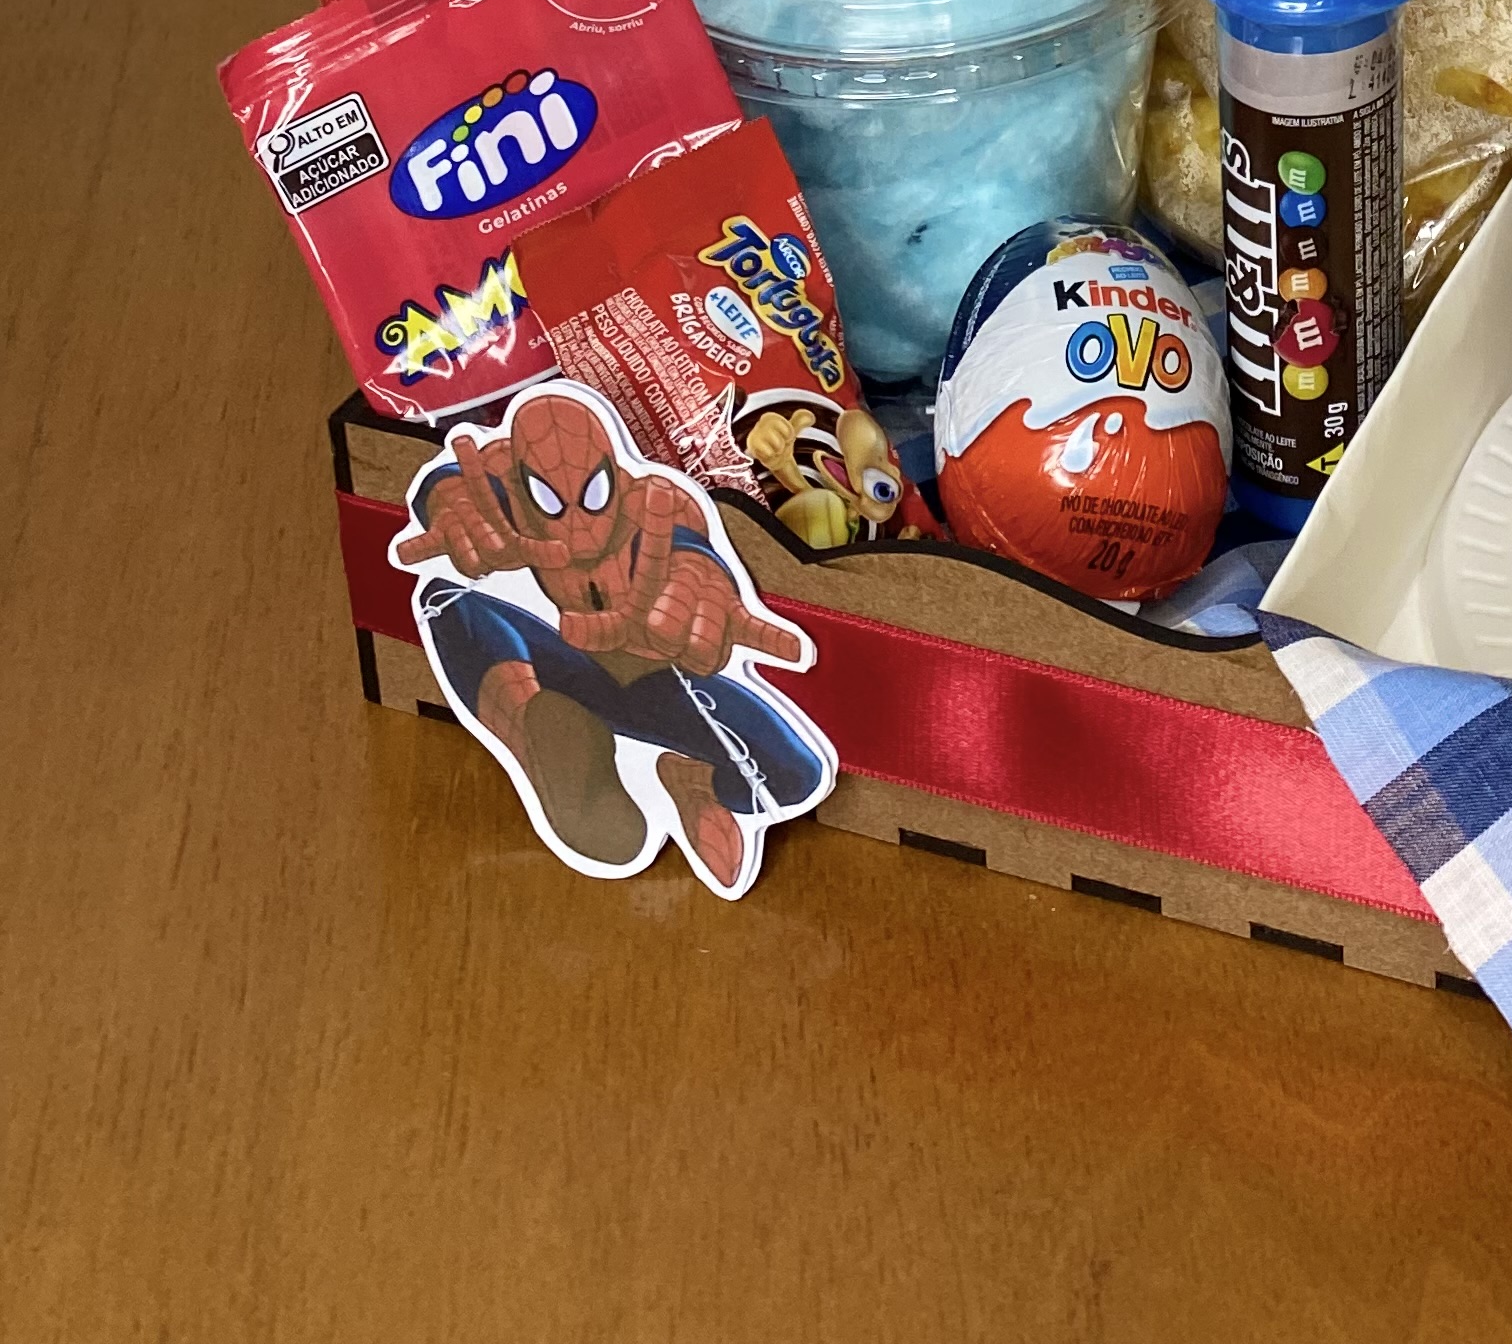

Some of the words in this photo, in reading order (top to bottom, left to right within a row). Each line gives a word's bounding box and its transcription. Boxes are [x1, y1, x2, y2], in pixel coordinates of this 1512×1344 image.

[569, 18, 606, 36] Abriu,
[608, 17, 644, 35] sorriu
[296, 118, 334, 149] ALTO
[334, 109, 360, 137] EM
[1272, 116, 1299, 127] IMAGEM
[1301, 114, 1345, 128] ILUSTRATIVA
[406, 71, 579, 213] Fini
[290, 152, 381, 206] ADICIONADO
[299, 143, 361, 184] AÇÚCAR
[1289, 168, 1306, 189] m
[478, 182, 568, 235] Gelatinas
[1297, 200, 1317, 223] m
[774, 237, 805, 279] ARCOR
[1291, 272, 1310, 291] m
[587, 302, 620, 339] PESO
[707, 223, 841, 387] Tortuguita
[1053, 280, 1192, 328] Kinder
[621, 285, 668, 339] CHOCOLATE
[658, 333, 679, 354] AO
[669, 347, 698, 380] LEITE
[684, 374, 713, 405] COM
[671, 291, 751, 375] BRIGADEIRO
[1292, 316, 1324, 351] m
[1066, 314, 1192, 393] OVO
[1265, 433, 1275, 443] AO
[1276, 435, 1296, 448] LEITE
[1324, 416, 1344, 438] 30
